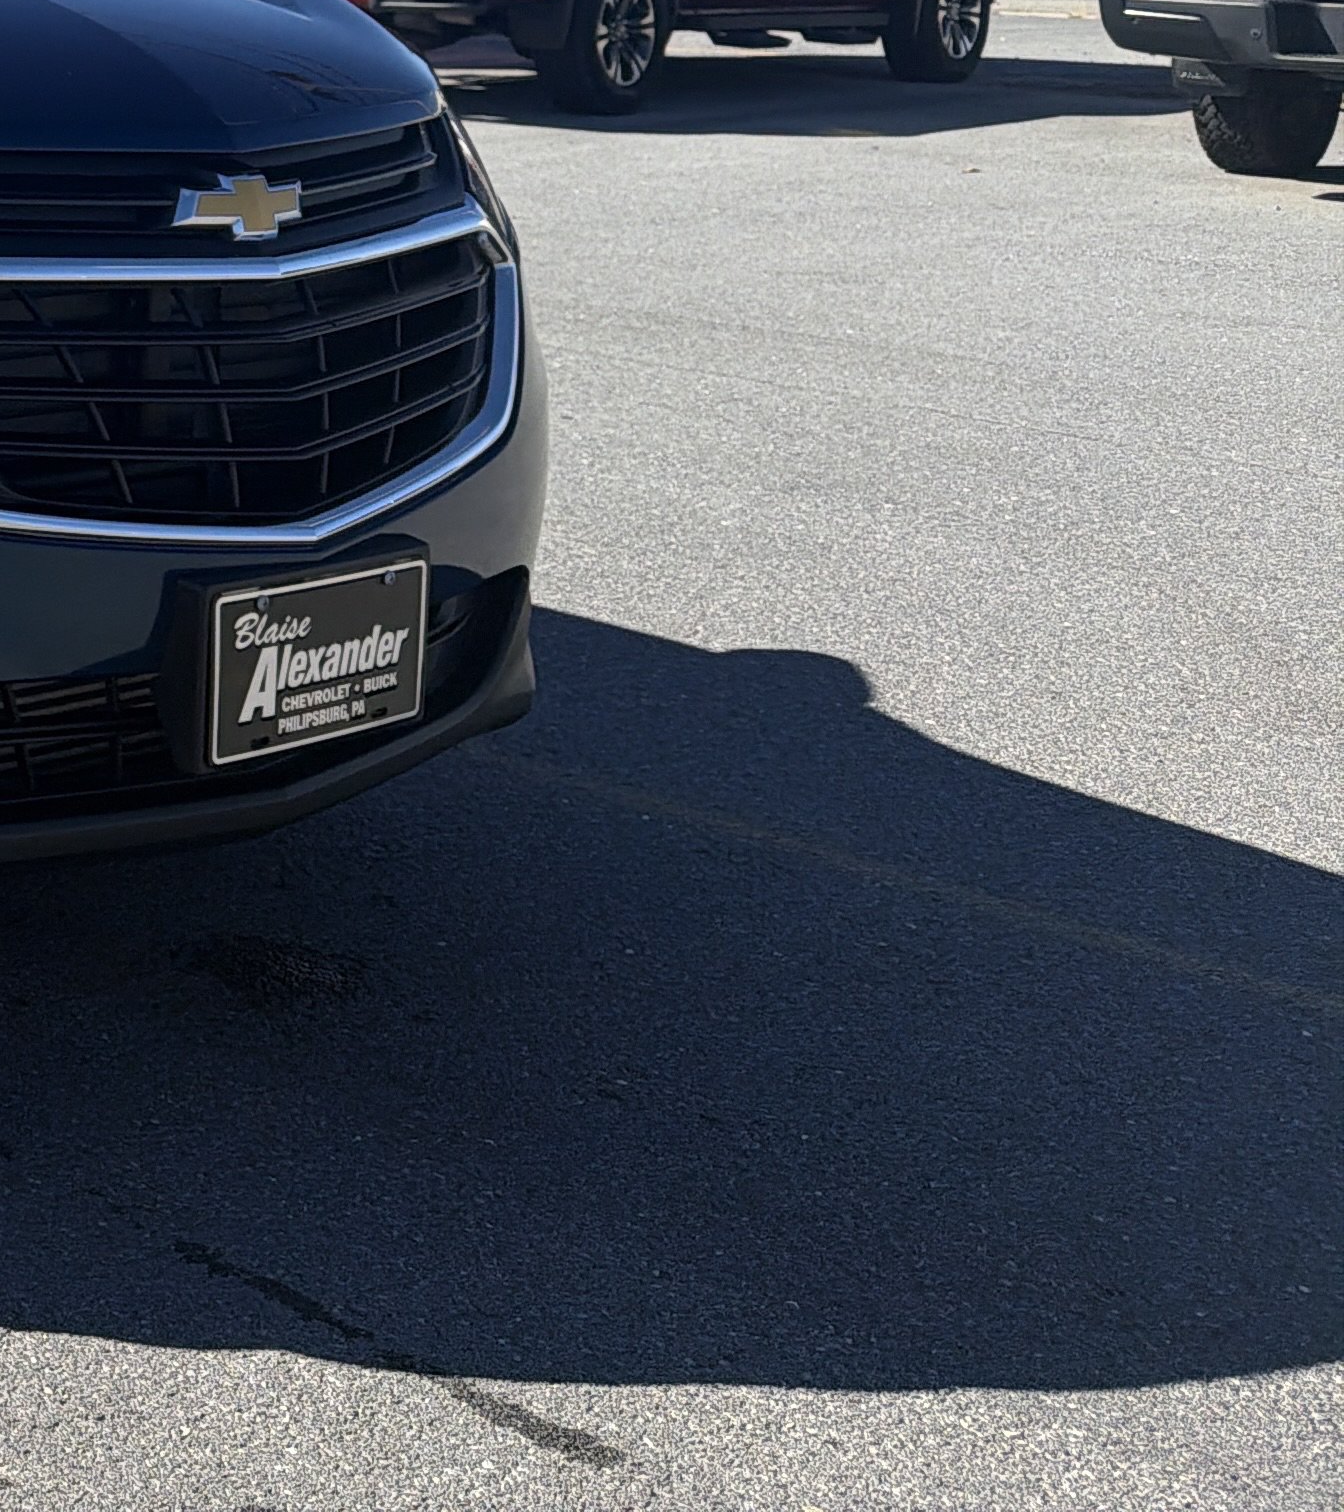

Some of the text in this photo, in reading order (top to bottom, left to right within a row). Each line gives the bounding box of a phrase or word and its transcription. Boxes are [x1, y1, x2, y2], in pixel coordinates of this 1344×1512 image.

[234, 612, 312, 650] Blaise
[238, 624, 410, 723] Alexander
[281, 672, 398, 712] CHEVROLET BUICK
[278, 700, 366, 735] PHILIPSBURG, PA
